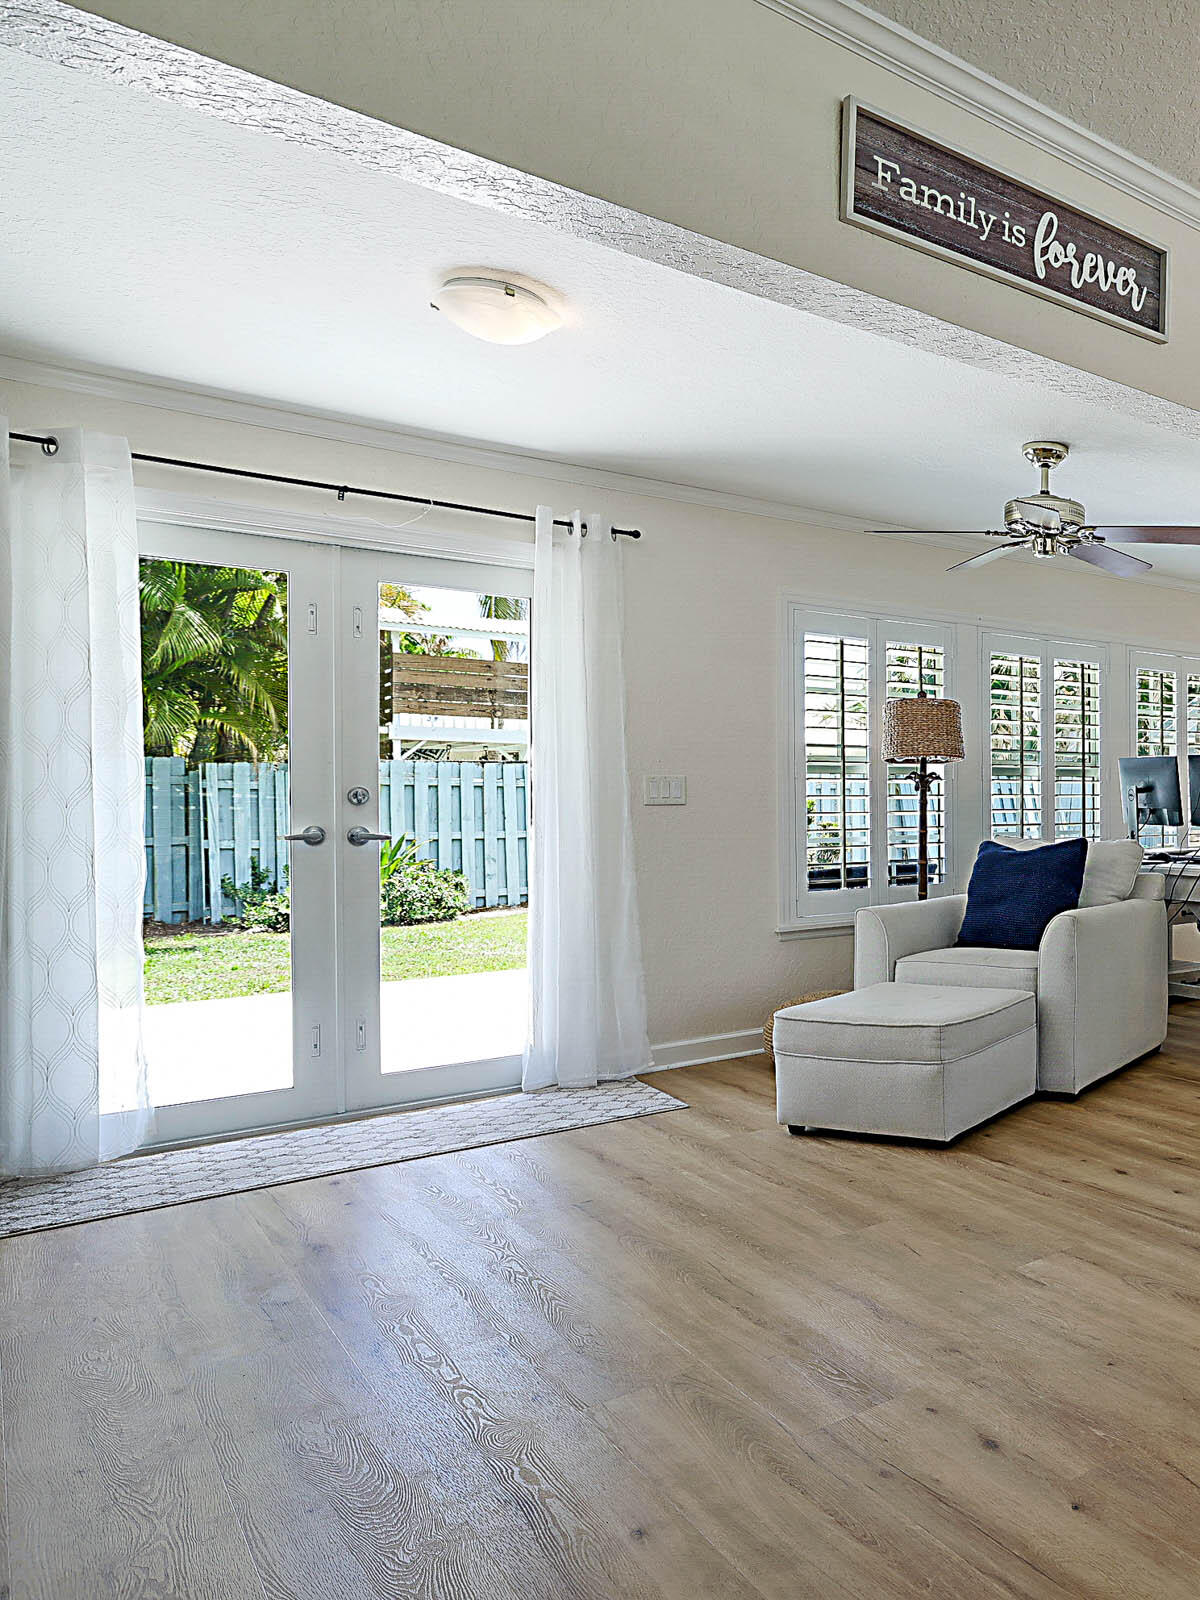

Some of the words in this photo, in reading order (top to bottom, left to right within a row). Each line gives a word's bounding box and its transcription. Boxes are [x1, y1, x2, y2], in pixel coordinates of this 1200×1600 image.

[871, 154, 997, 241] Family
[1002, 211, 1026, 248] is
[1034, 211, 1148, 312] forever
